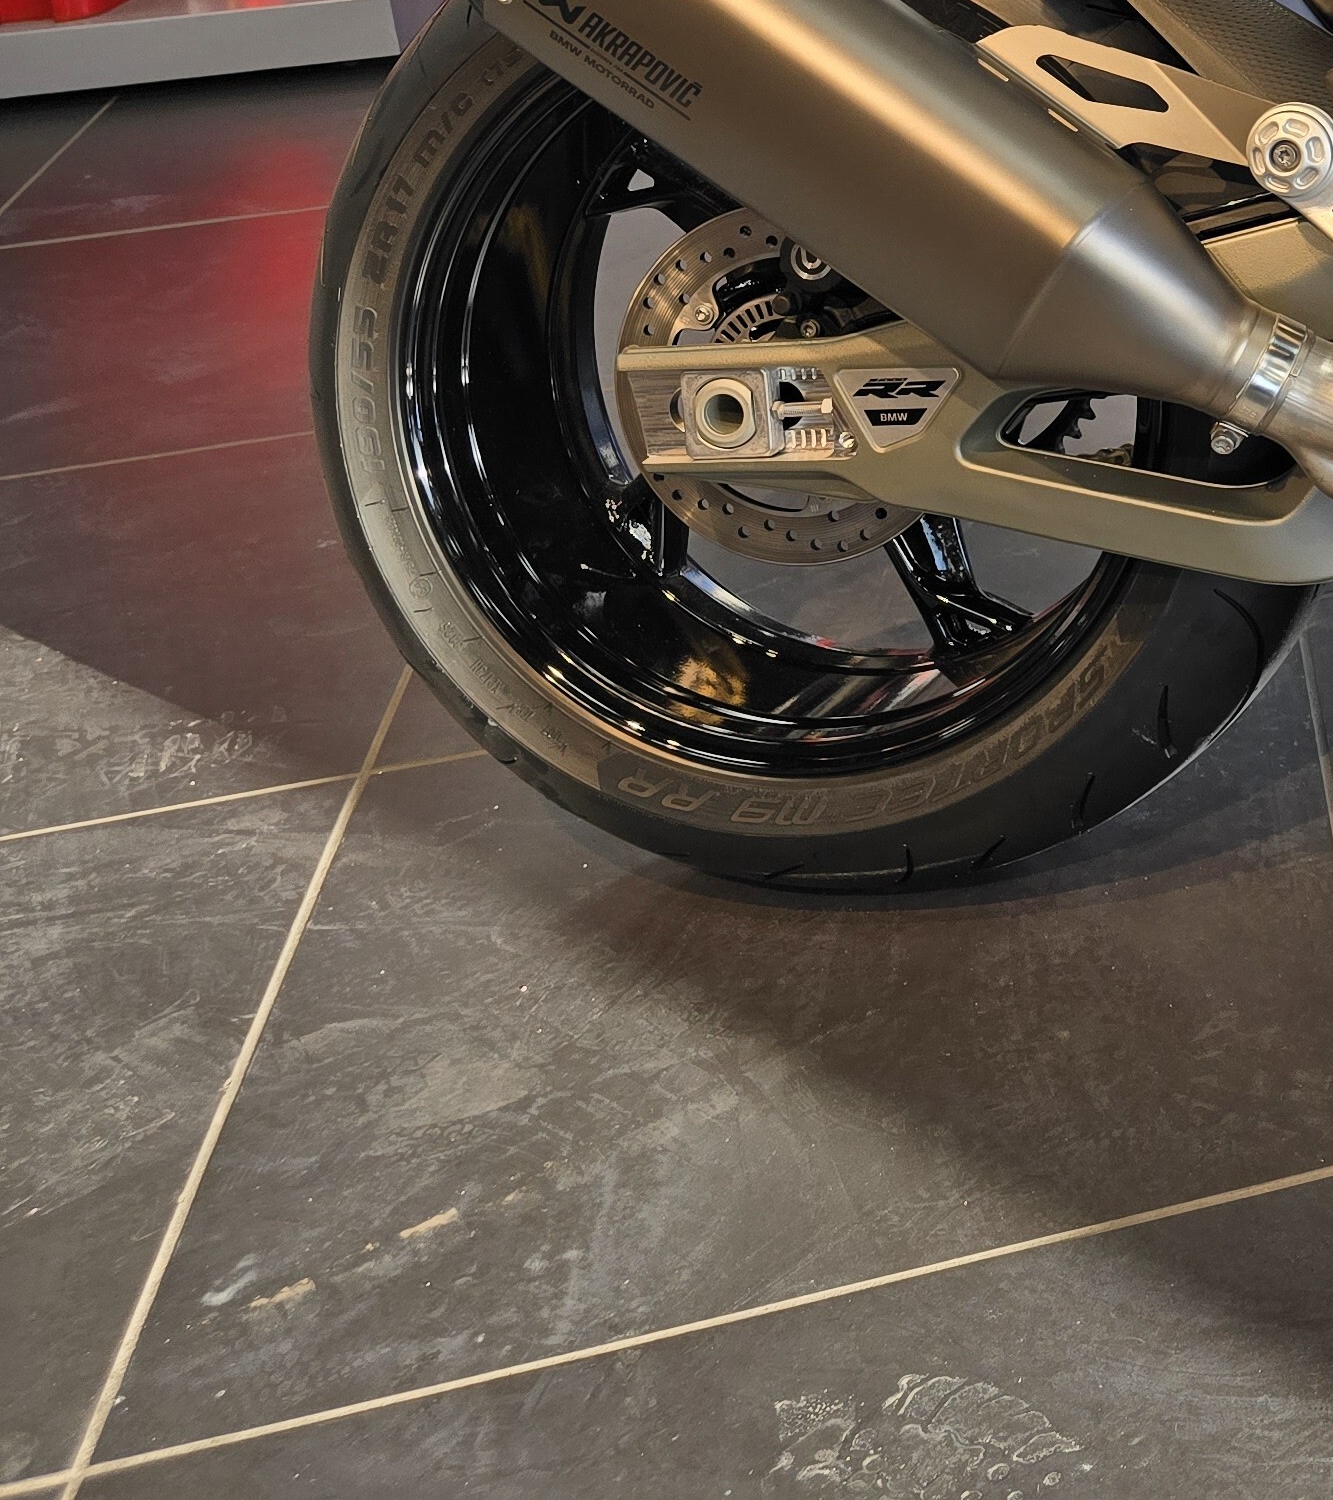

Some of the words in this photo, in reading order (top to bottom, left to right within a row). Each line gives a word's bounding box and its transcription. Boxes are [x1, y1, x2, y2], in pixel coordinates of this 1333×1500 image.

[550, 30, 581, 57] BMW
[584, 55, 655, 109] MOTORRAD
[578, 12, 703, 109] AKRAPOVIČ
[853, 380, 946, 399] RR
[880, 413, 908, 422] BMW
